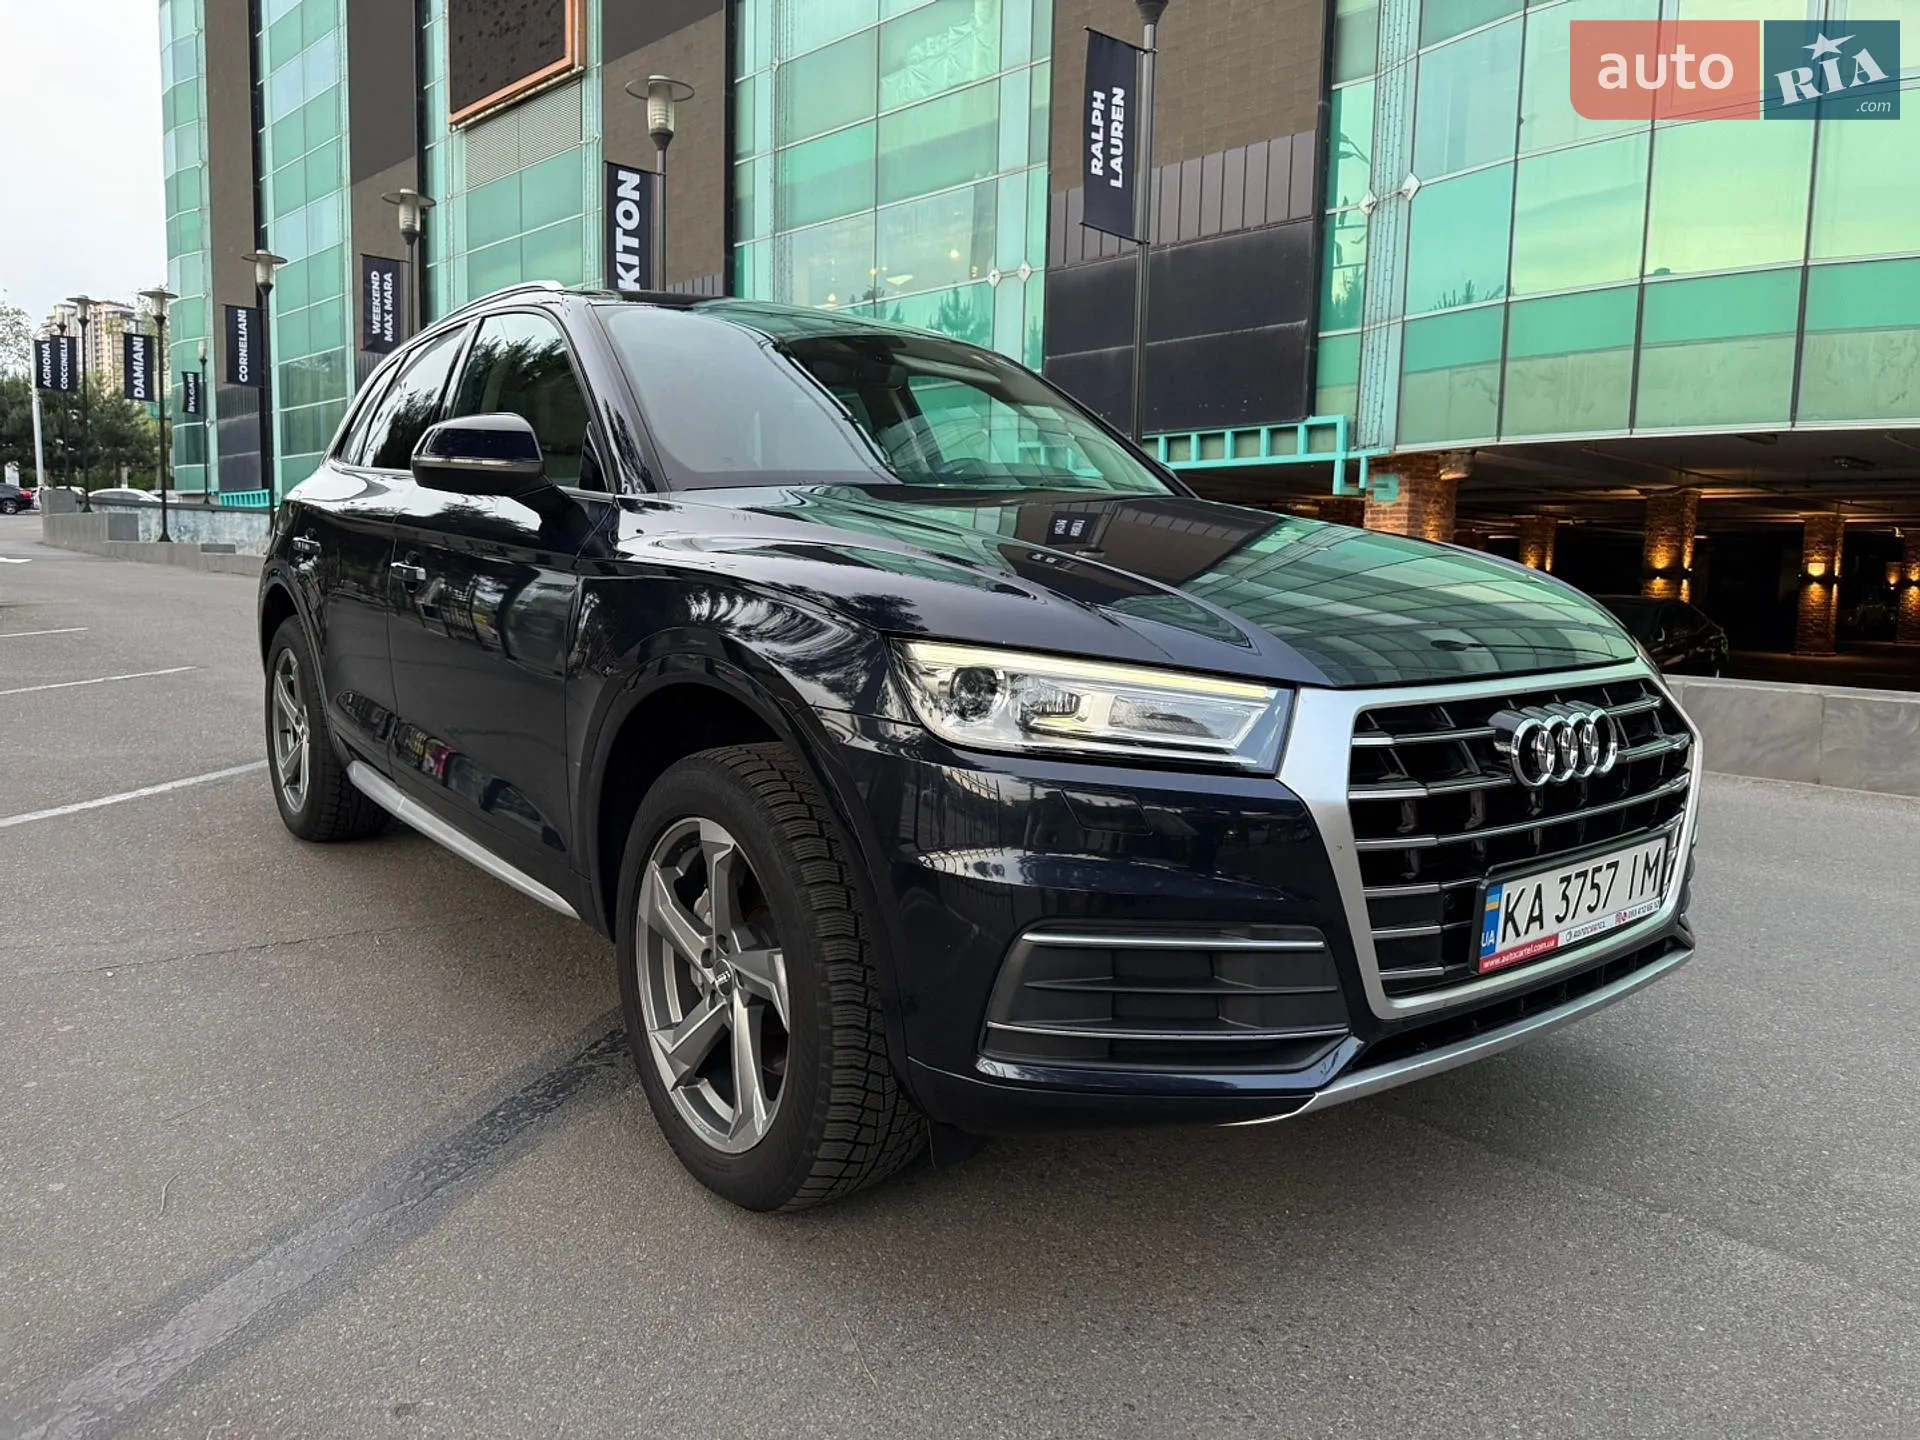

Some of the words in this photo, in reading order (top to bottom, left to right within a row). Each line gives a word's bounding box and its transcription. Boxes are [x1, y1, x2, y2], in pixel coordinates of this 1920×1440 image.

[1090, 91, 1105, 176] RALPH
[1110, 87, 1125, 188] LAUREN
[615, 169, 640, 291] KITON
[371, 271, 381, 334] WEEKEND
[383, 272, 393, 311] MARA
[237, 309, 248, 382] CORNELIANI
[384, 312, 393, 342] MAX
[41, 342, 51, 388] AGNONA
[132, 336, 145, 398] DAMIANI
[1501, 883, 1544, 943] KA
[1554, 860, 1620, 924] 3757
[1627, 847, 1662, 900] IM
[1481, 929, 1494, 947] UA
